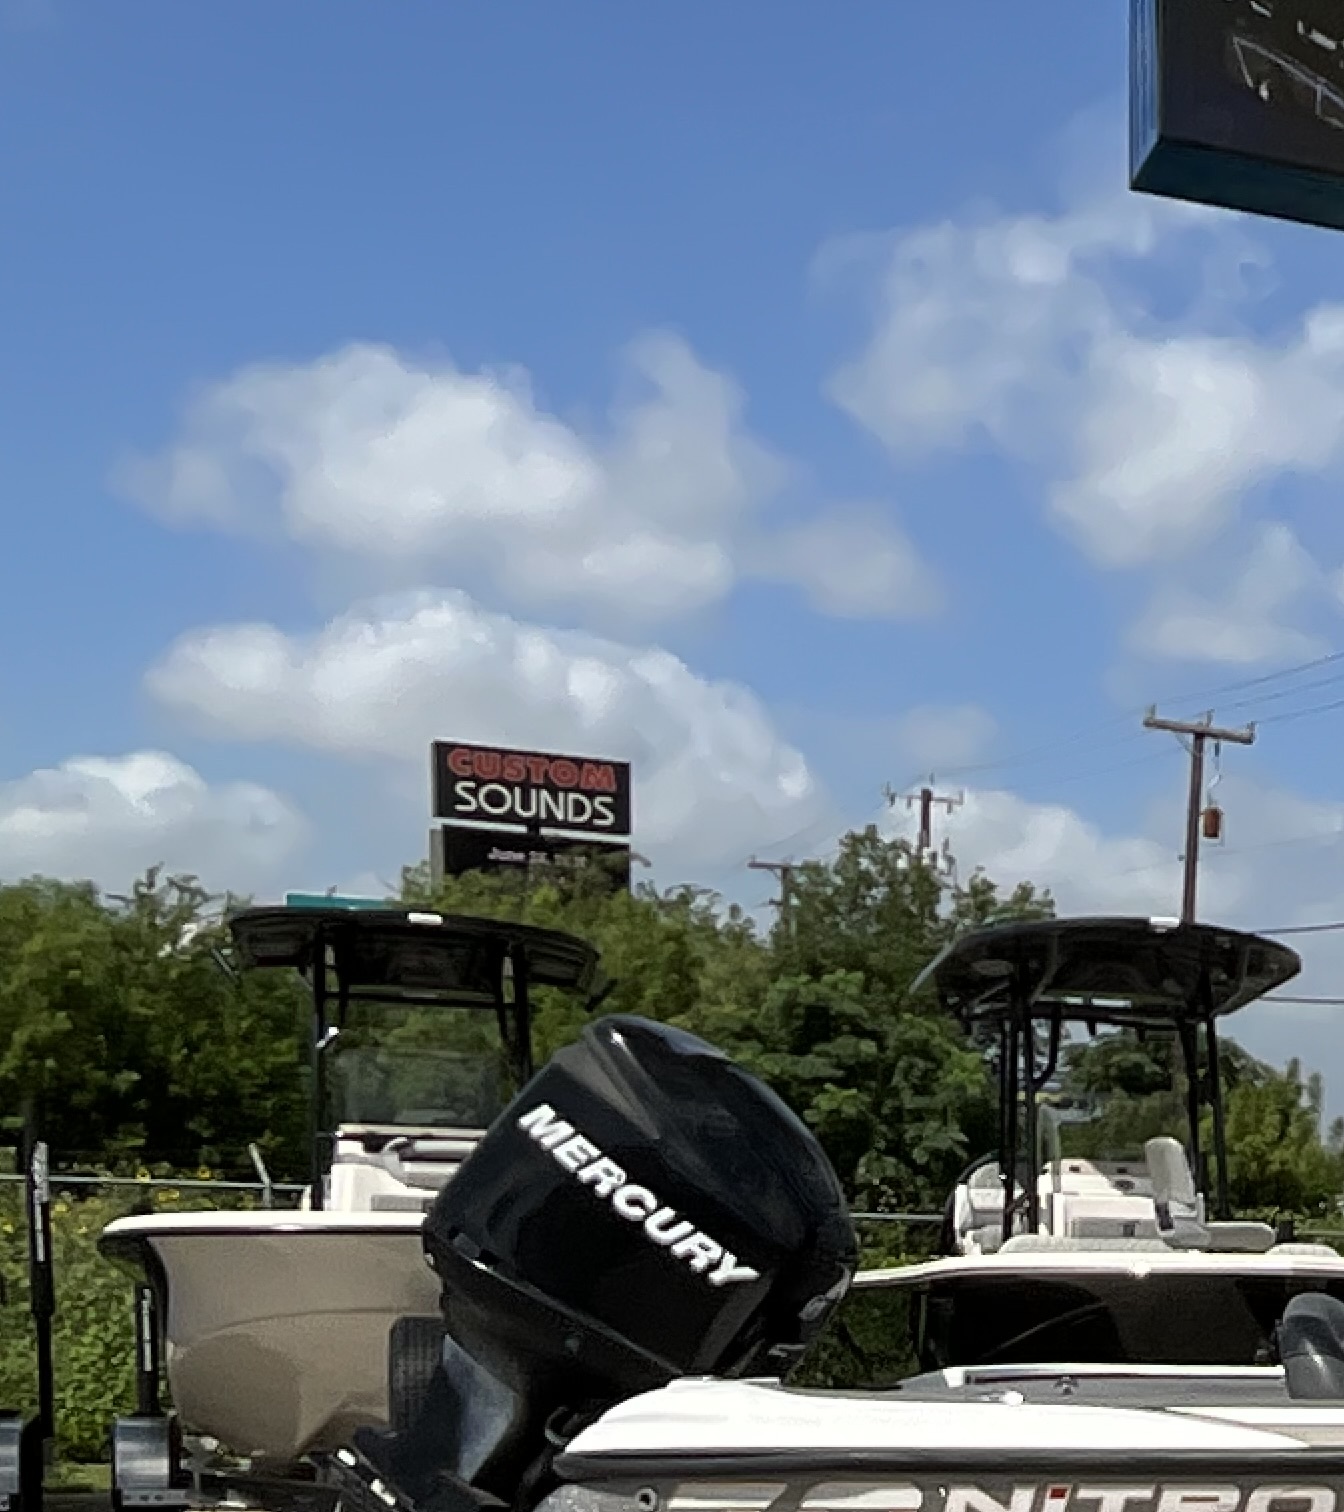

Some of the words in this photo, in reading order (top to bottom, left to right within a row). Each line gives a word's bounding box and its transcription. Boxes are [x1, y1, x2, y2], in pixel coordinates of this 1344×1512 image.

[447, 749, 617, 792] CUSTOM
[454, 780, 616, 826] SOUNDS
[517, 1102, 760, 1286] MERCURY
